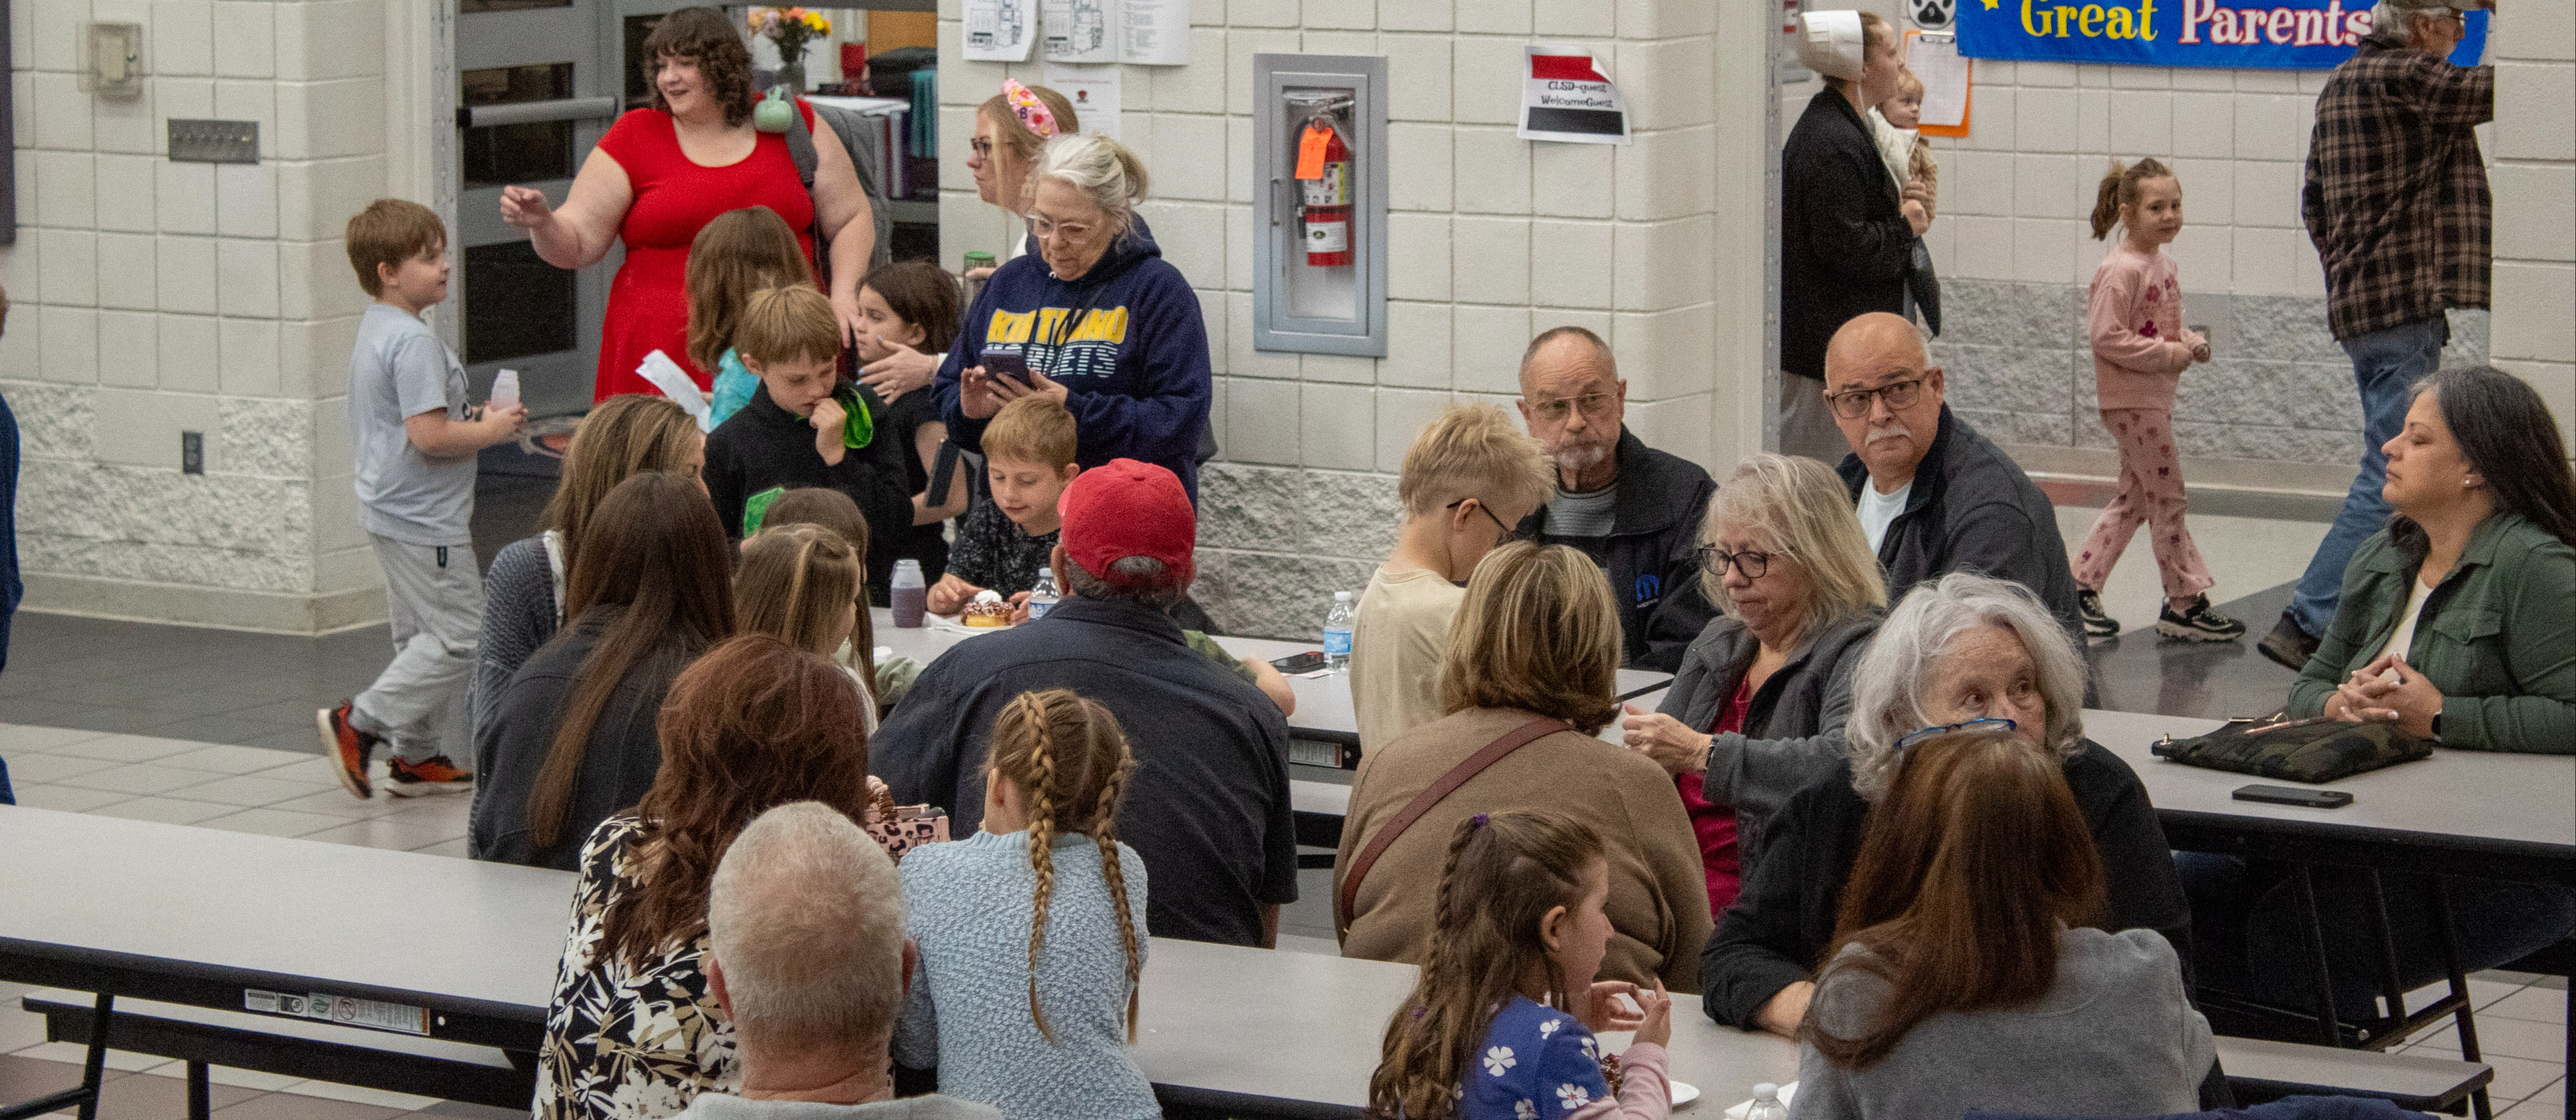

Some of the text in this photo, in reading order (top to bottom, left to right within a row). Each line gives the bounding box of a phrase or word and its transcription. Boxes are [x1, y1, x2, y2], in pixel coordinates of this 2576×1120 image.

[2021, 0, 2371, 46] Great Parents
[1548, 81, 1607, 94] CLSD-guest
[1542, 96, 1613, 108] WelcomeGuest
